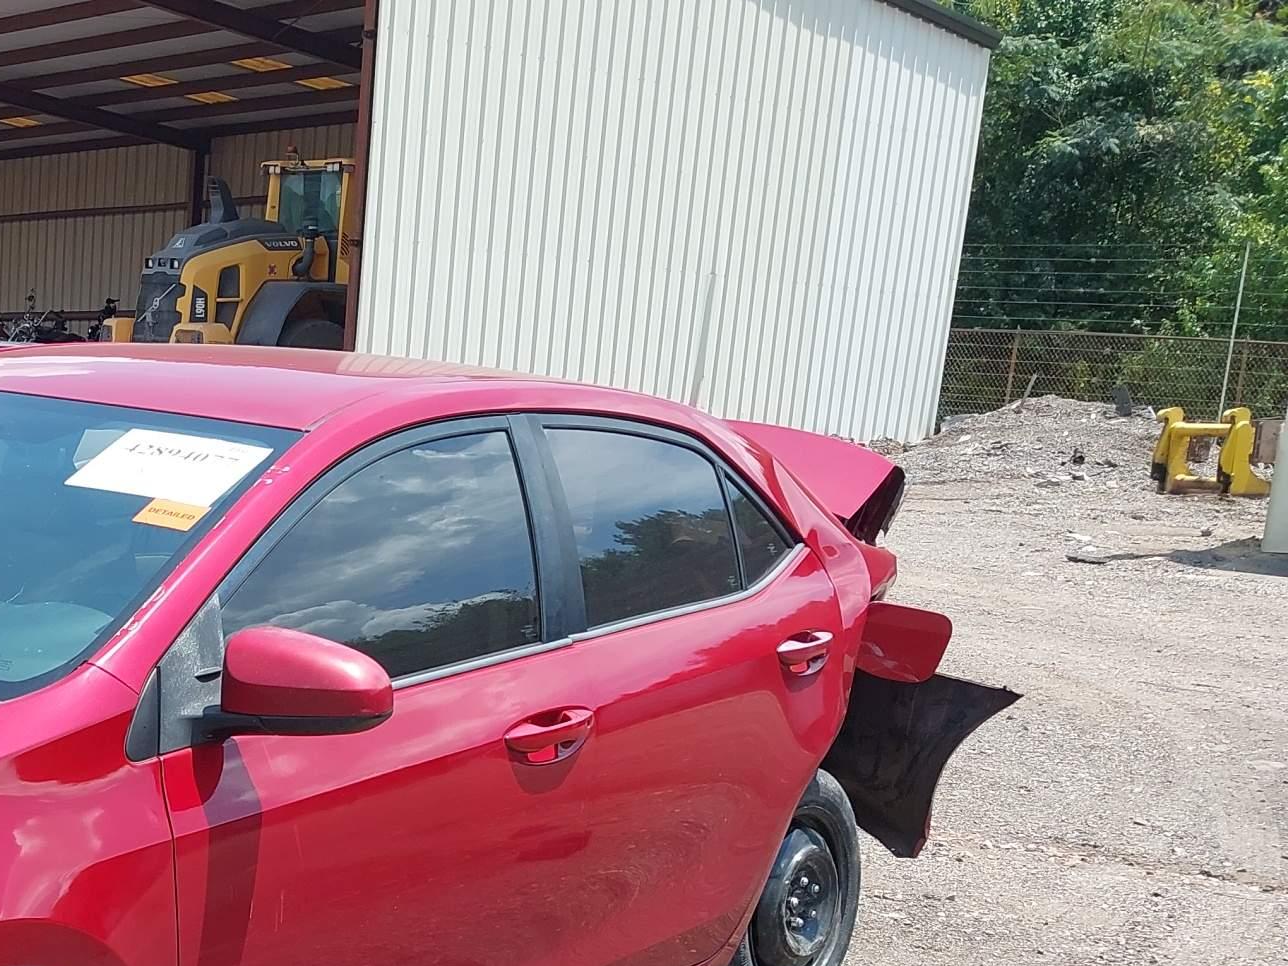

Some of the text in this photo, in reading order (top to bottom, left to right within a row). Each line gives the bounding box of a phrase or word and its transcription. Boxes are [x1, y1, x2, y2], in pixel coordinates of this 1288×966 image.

[265, 240, 298, 248] VOLVO
[195, 297, 206, 318] L90H
[147, 506, 196, 521] DETAILED
